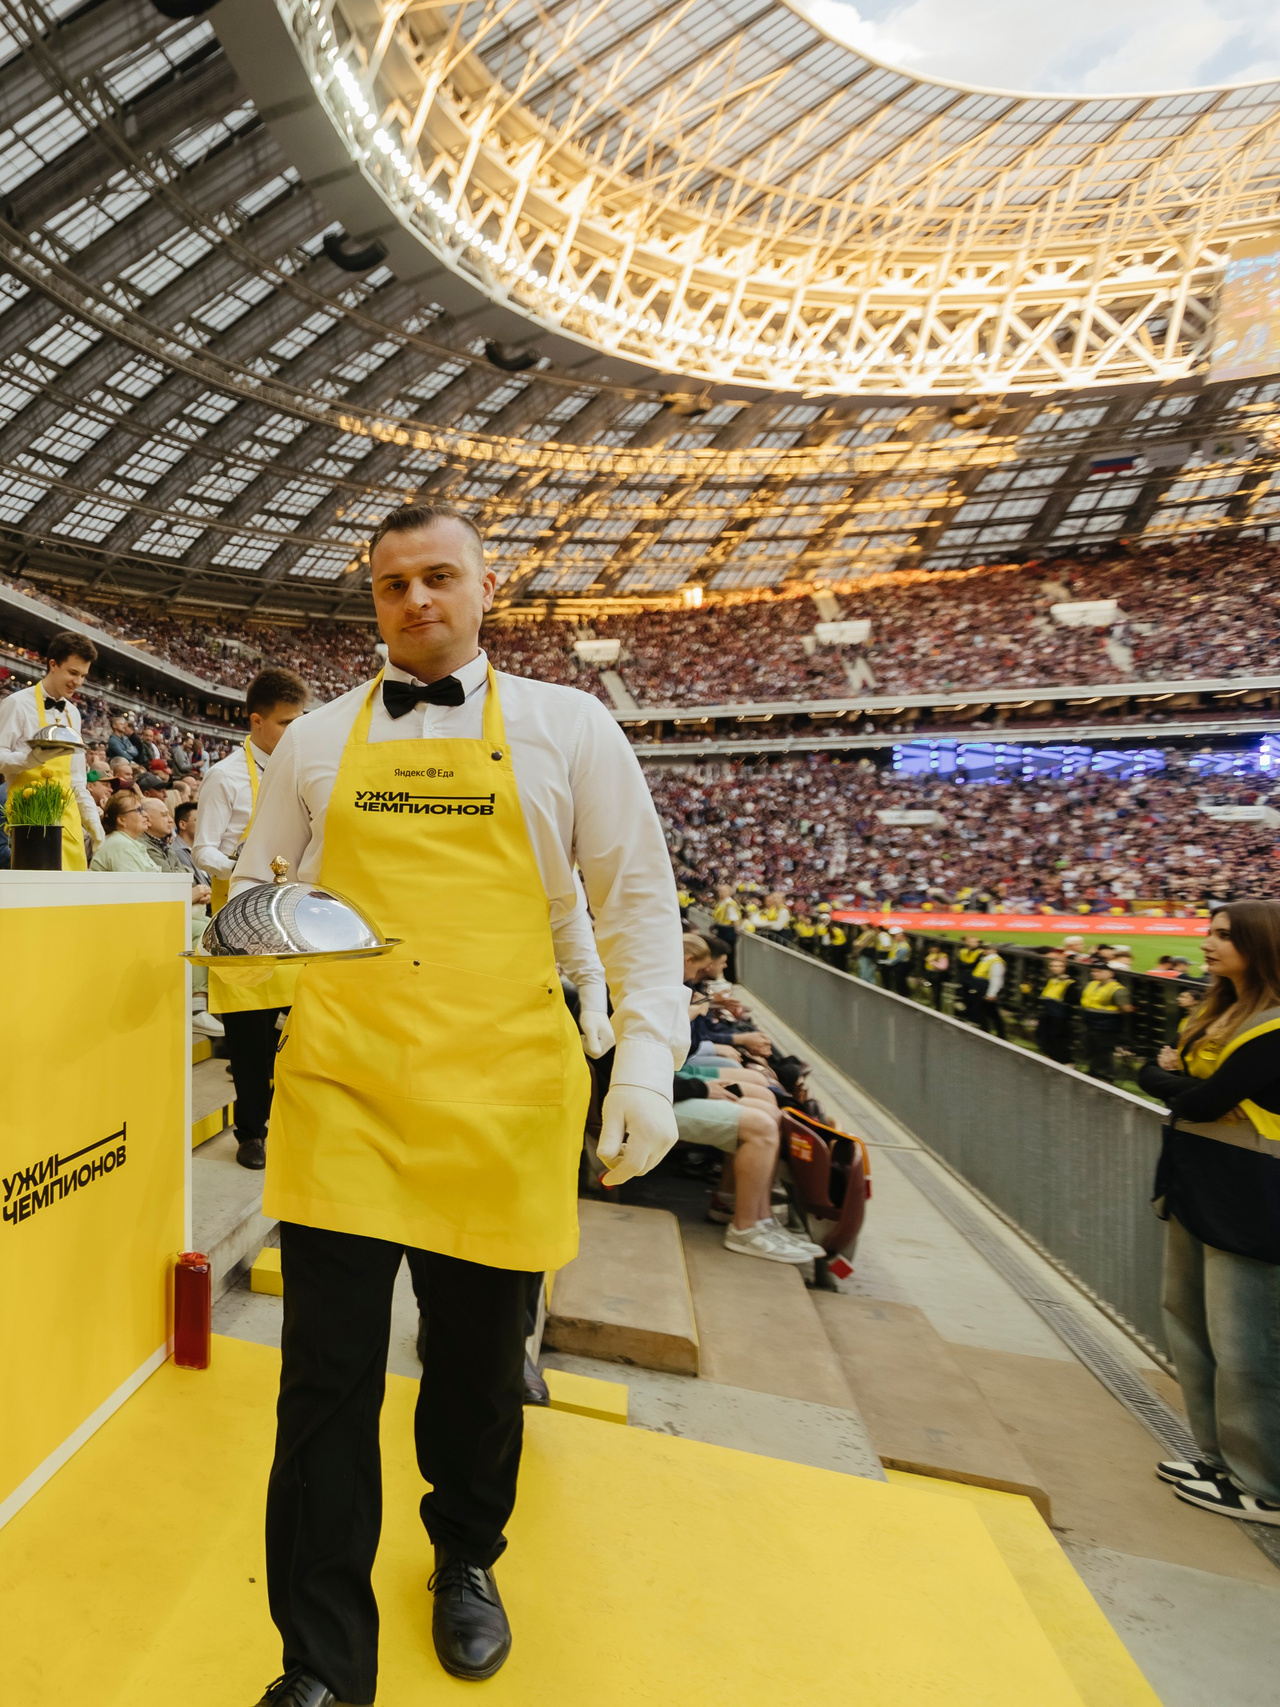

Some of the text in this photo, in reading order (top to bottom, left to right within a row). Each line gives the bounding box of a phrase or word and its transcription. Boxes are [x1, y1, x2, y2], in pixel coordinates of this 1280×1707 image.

[394, 768, 454, 778] Яндекс Еда
[355, 790, 495, 804] УЖИН
[354, 801, 494, 816] ЧЕМПИОНОВ
[1, 1121, 127, 1203] УЖИН
[2, 1145, 127, 1226] ЧЕМПИОНОВ
